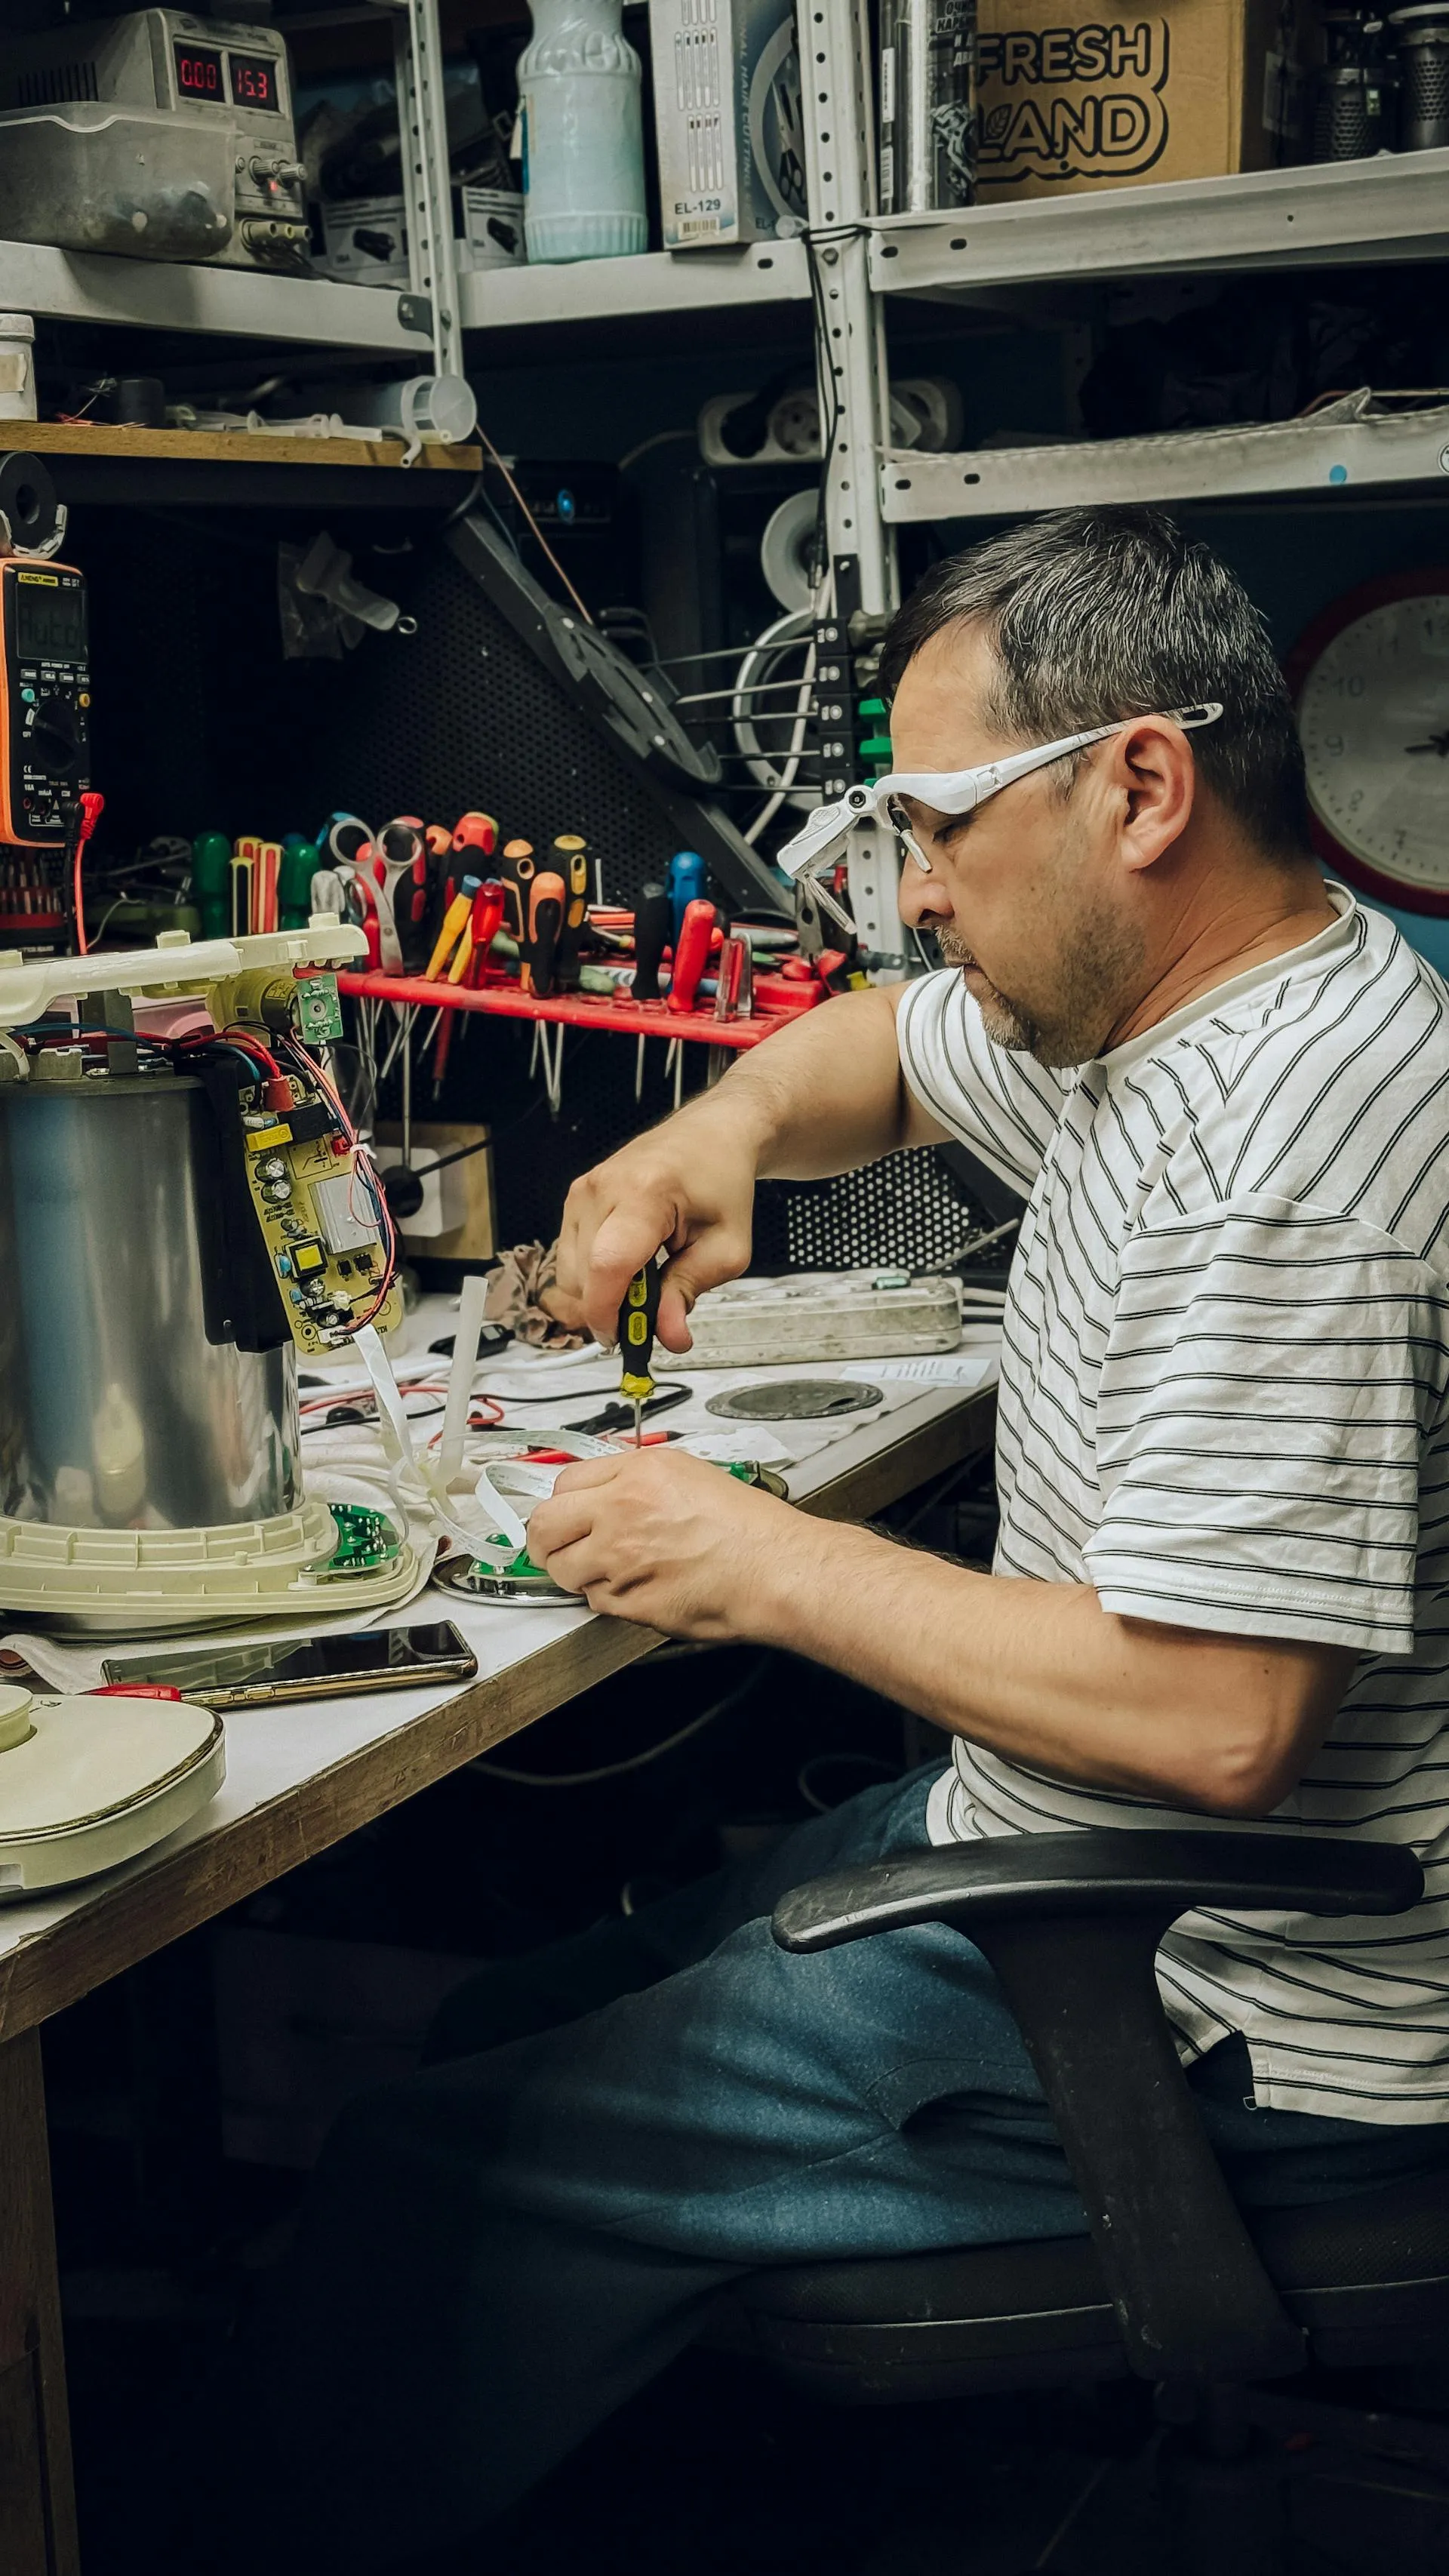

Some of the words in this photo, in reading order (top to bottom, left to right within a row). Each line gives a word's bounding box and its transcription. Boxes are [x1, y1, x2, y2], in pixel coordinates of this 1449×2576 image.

[977, 23, 1152, 85] FRESH
[740, 65, 749, 106] HAIR
[743, 112, 752, 186] CUTTING
[977, 94, 1151, 164] LAND
[675, 199, 721, 214] EL-129
[1333, 676, 1364, 698] 10
[1324, 734, 1344, 757] 9
